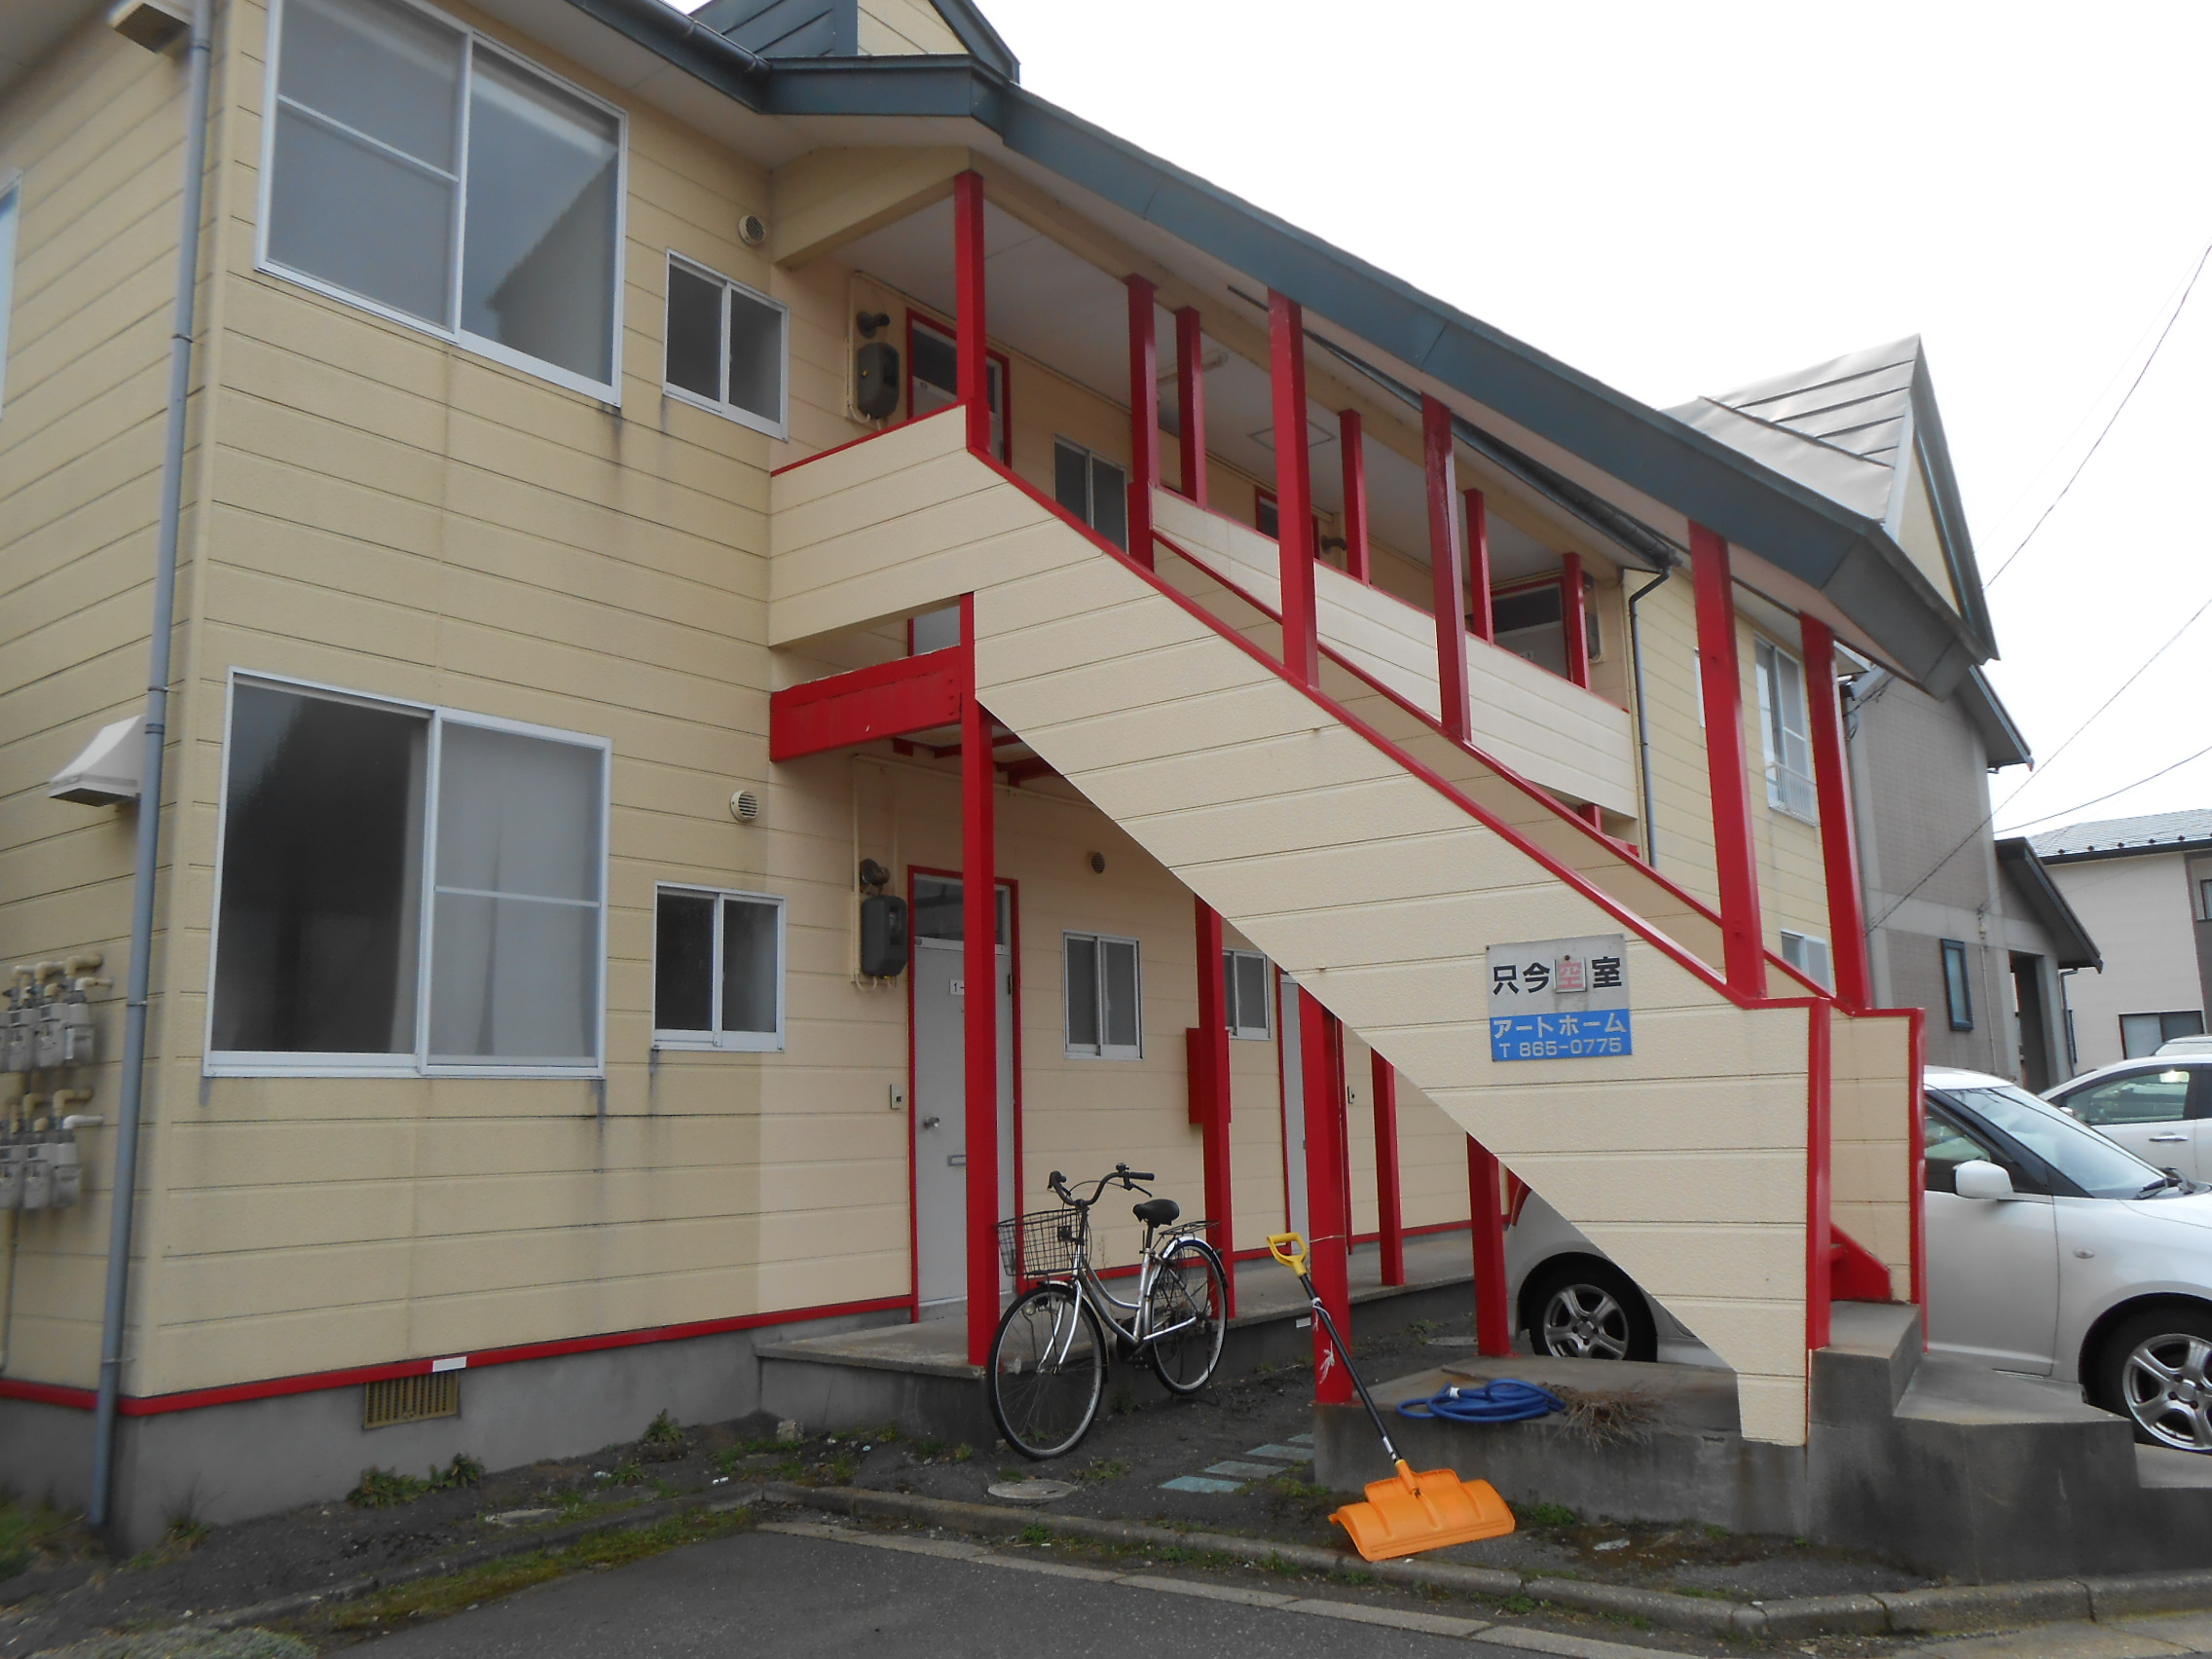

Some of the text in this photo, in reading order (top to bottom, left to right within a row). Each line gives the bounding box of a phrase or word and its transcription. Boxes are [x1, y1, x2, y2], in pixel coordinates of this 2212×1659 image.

[1493, 956, 1622, 995] 只今空室
[1493, 1013, 1627, 1039] アートホーム
[1519, 1037, 1622, 1057] 865-0775
